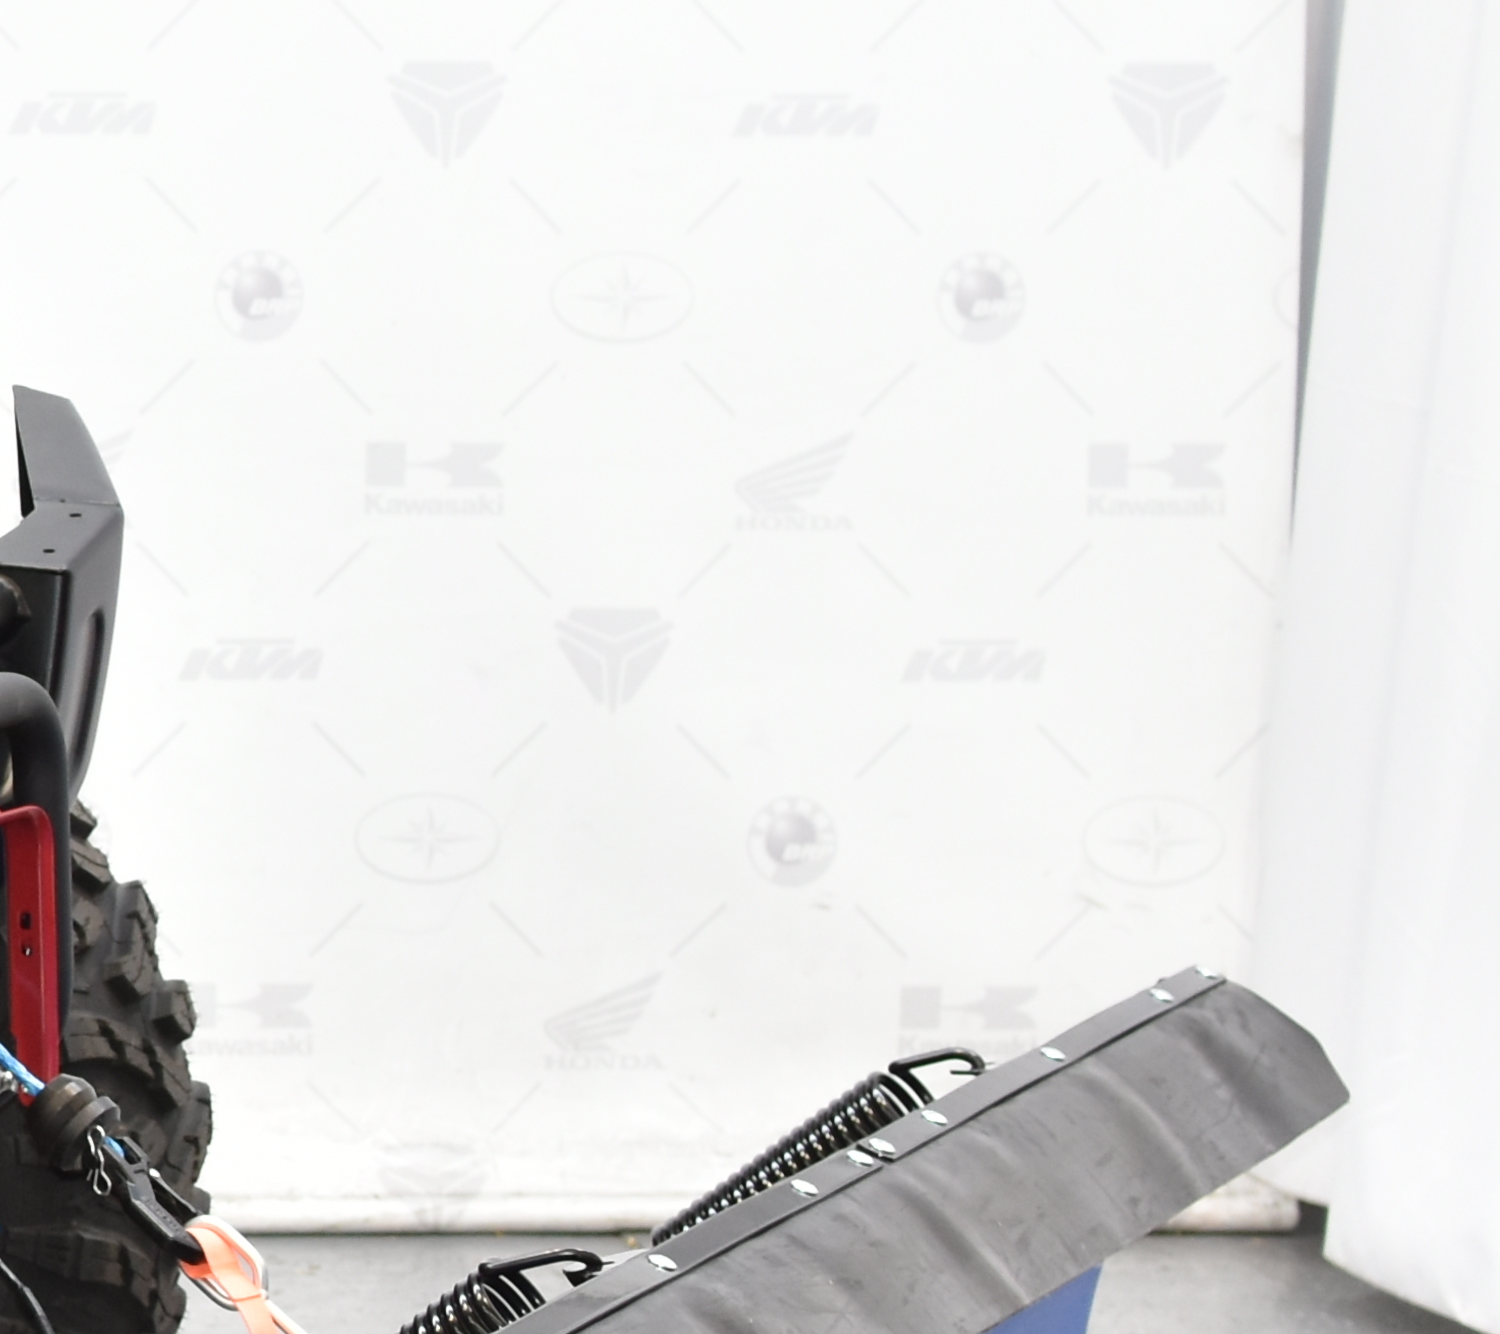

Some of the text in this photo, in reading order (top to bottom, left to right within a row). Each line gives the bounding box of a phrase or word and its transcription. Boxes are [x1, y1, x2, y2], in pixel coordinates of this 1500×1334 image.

[10, 91, 157, 135] KTM
[733, 91, 881, 139] KTM
[179, 638, 323, 681] KTM
[901, 639, 1046, 682] KTM
[193, 1034, 314, 1057] awasaki
